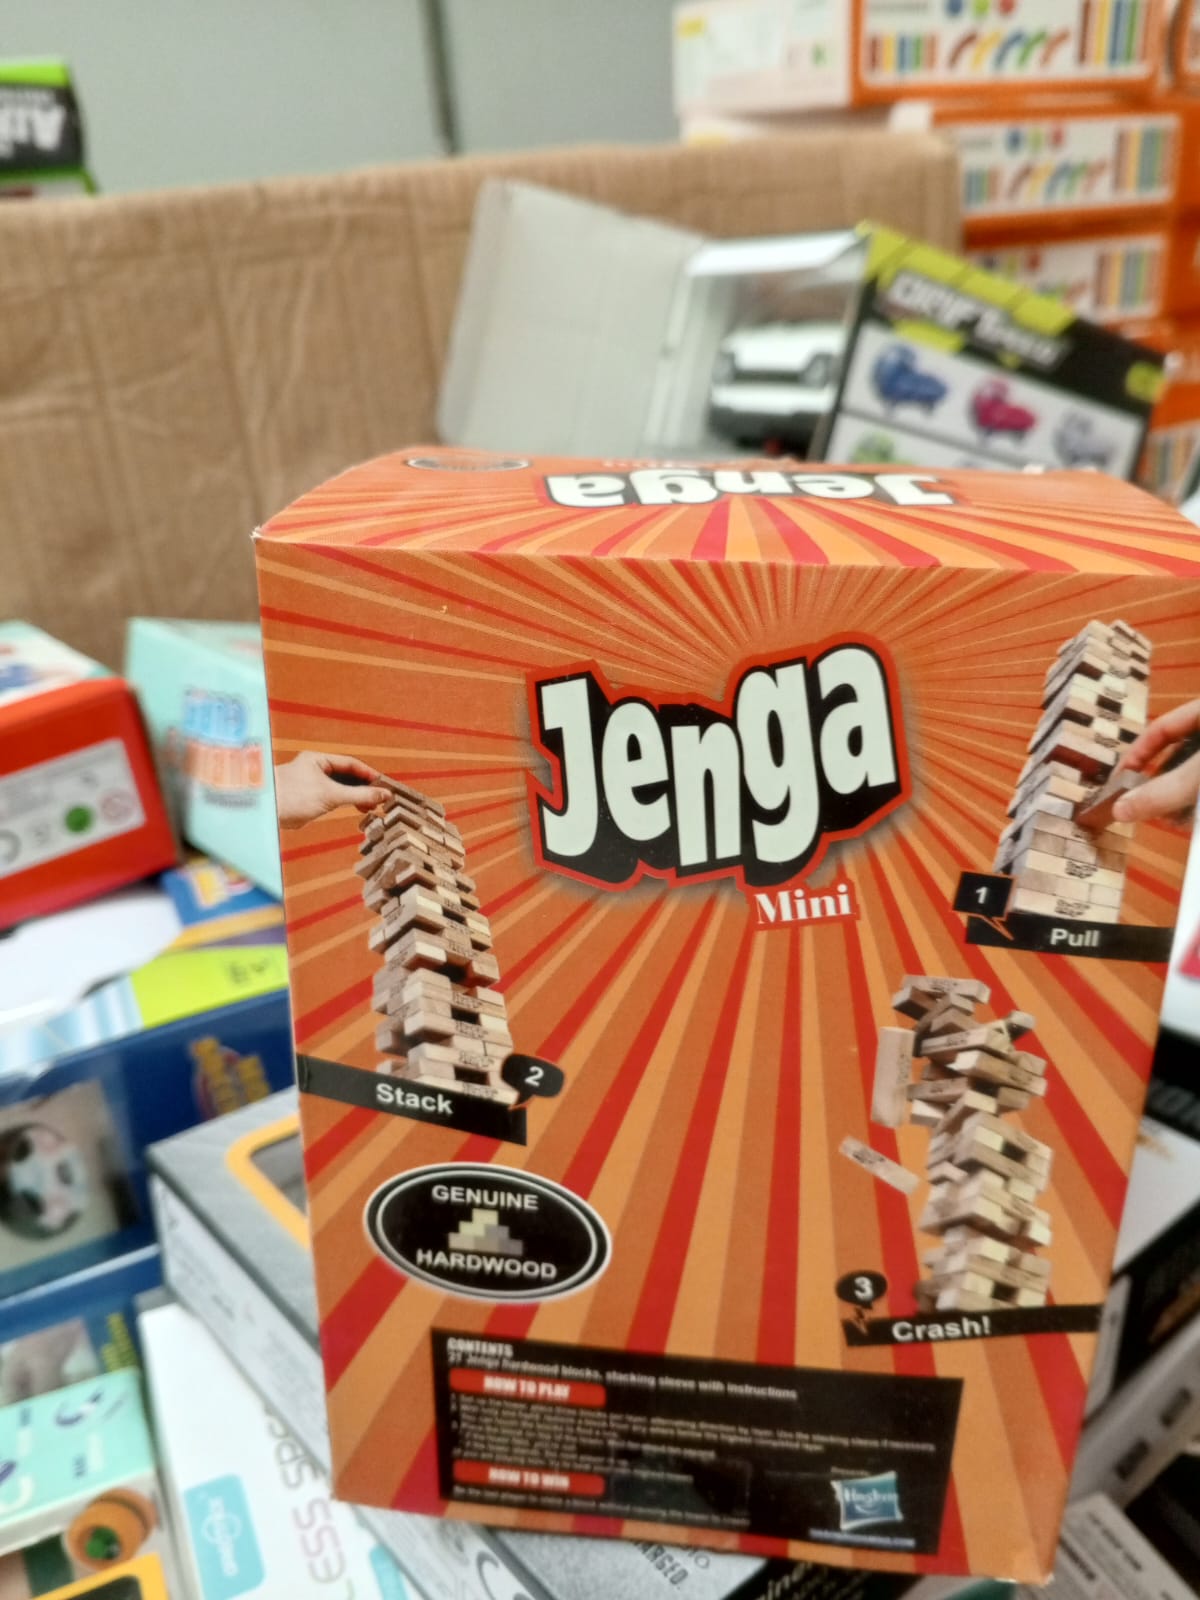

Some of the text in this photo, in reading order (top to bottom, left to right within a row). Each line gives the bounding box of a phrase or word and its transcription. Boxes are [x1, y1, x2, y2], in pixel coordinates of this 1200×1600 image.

[545, 468, 954, 507] Jenga
[537, 645, 899, 868] Jenga
[754, 883, 855, 924] Mini
[974, 885, 989, 905] 1
[1049, 927, 1100, 948] Pull
[524, 1065, 545, 1087] 2
[375, 1082, 454, 1115] Stack
[431, 1184, 539, 1211] GENUINE
[415, 1248, 558, 1281] HARDWOOD
[853, 1275, 875, 1301] 3
[891, 1315, 992, 1343] Crash!
[483, 1375, 570, 1401] HOW TO PLAY
[501, 1358, 559, 1375] hardwood
[605, 1370, 656, 1390] stacking
[698, 1380, 725, 1393] with
[727, 1382, 798, 1400] instructions
[488, 1466, 522, 1486] HOW
[523, 1470, 541, 1488] TO
[541, 1472, 571, 1492] WIN
